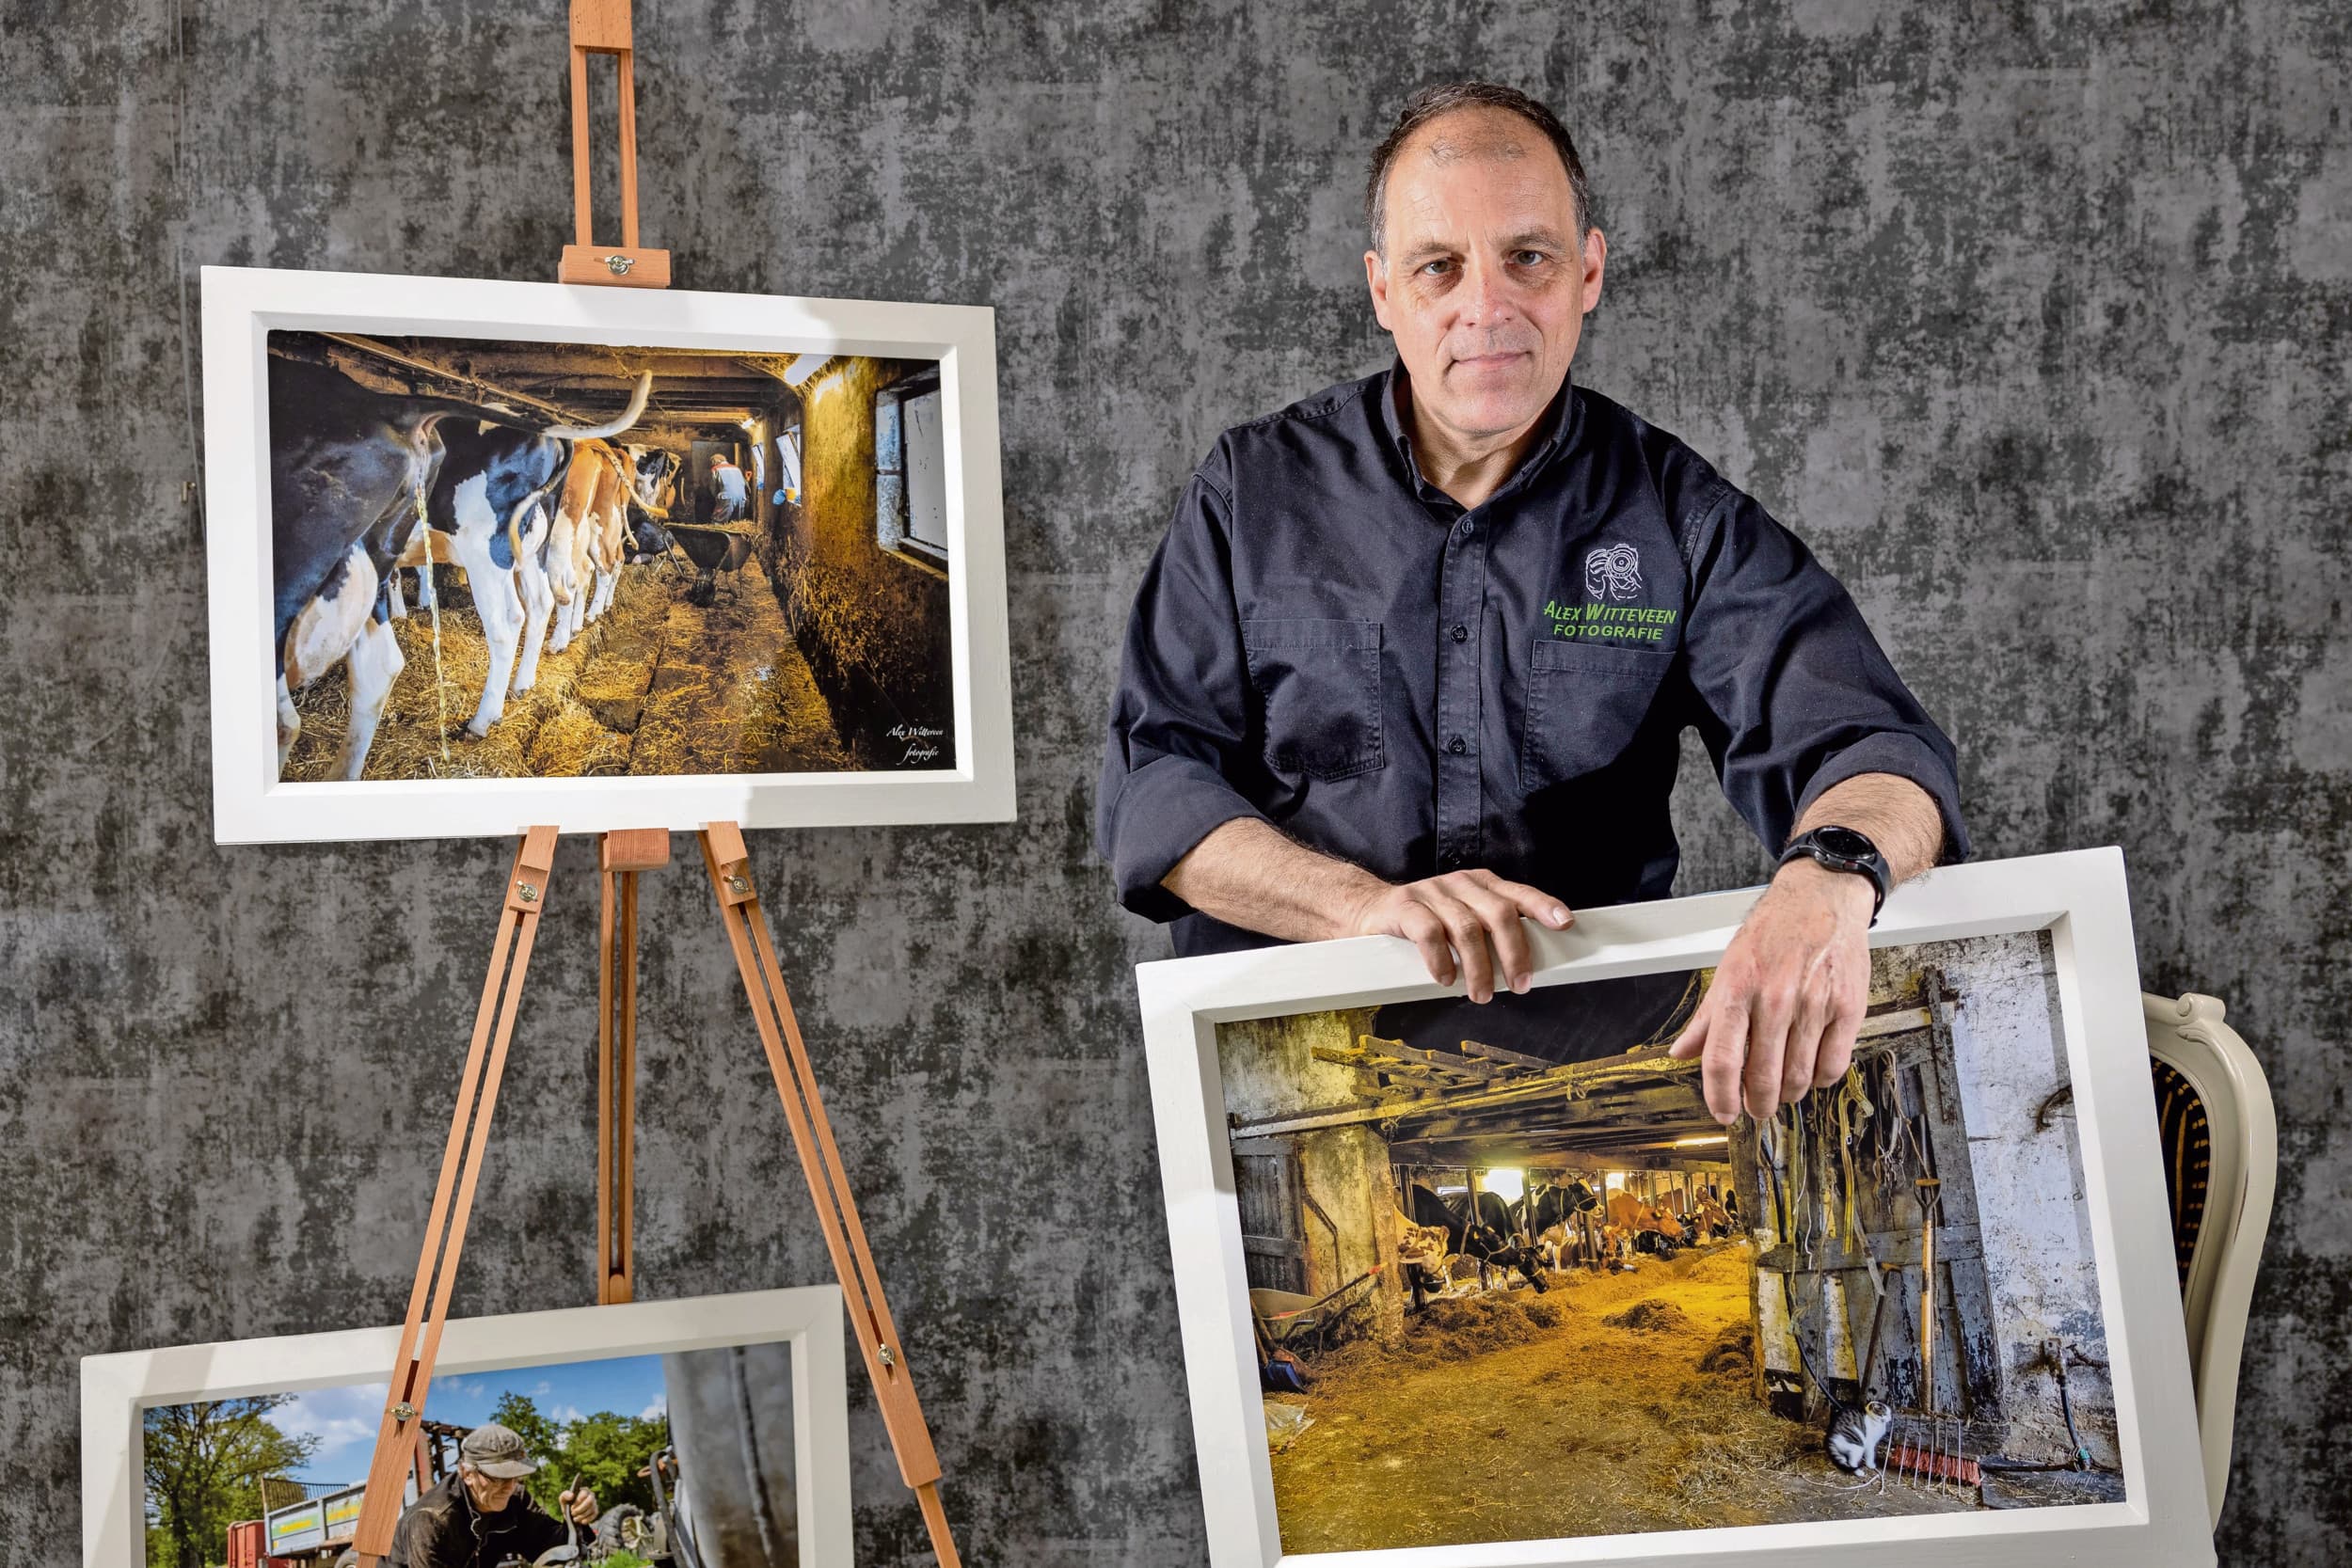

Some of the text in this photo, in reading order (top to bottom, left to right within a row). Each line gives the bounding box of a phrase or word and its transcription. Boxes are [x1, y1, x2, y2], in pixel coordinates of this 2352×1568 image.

[1544, 600, 1677, 625] ALEX WITTEVEEN
[1554, 625, 1663, 640] FOTOGRAFIE
[886, 723, 906, 741] Alex
[896, 743, 940, 766] fotografie
